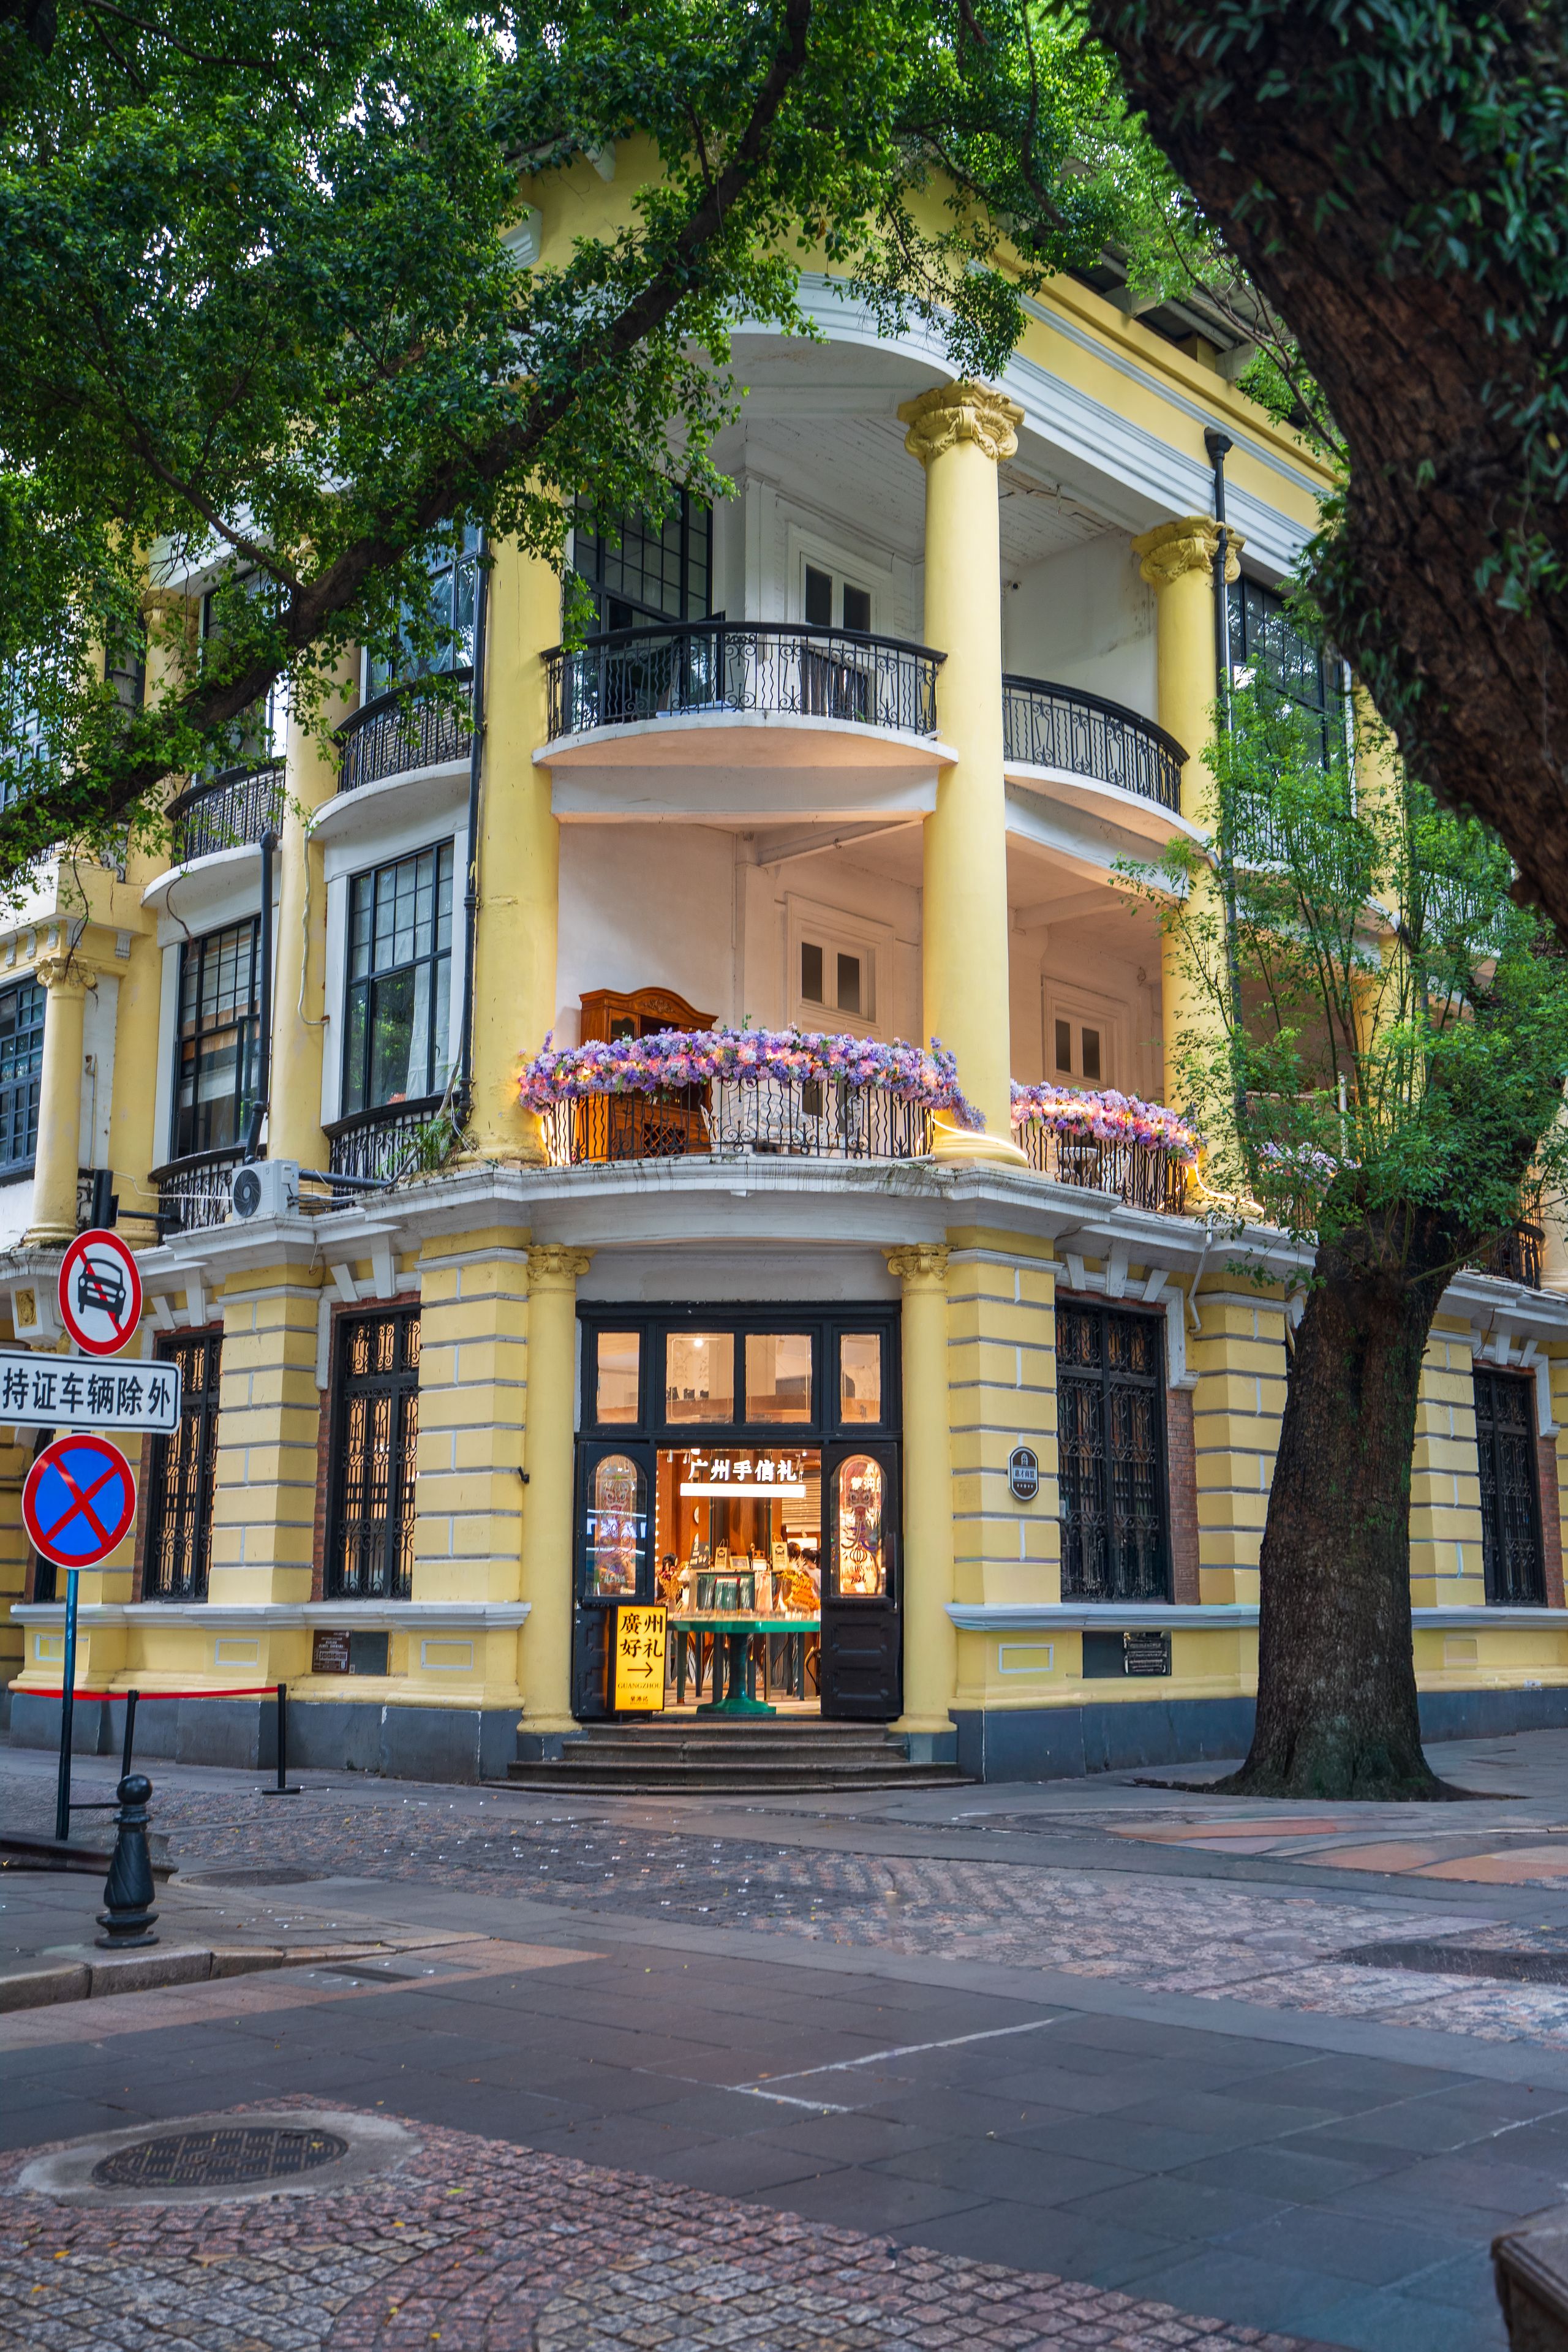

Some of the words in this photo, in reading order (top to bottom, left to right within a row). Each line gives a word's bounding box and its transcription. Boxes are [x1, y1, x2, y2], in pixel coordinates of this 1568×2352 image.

[2, 1367, 171, 1418] 持证车辆除外
[688, 1458, 797, 1482] 广州手信礼
[851, 1574, 866, 1585] 2026
[620, 1613, 663, 1635] 廣州
[620, 1638, 663, 1659] 好礼
